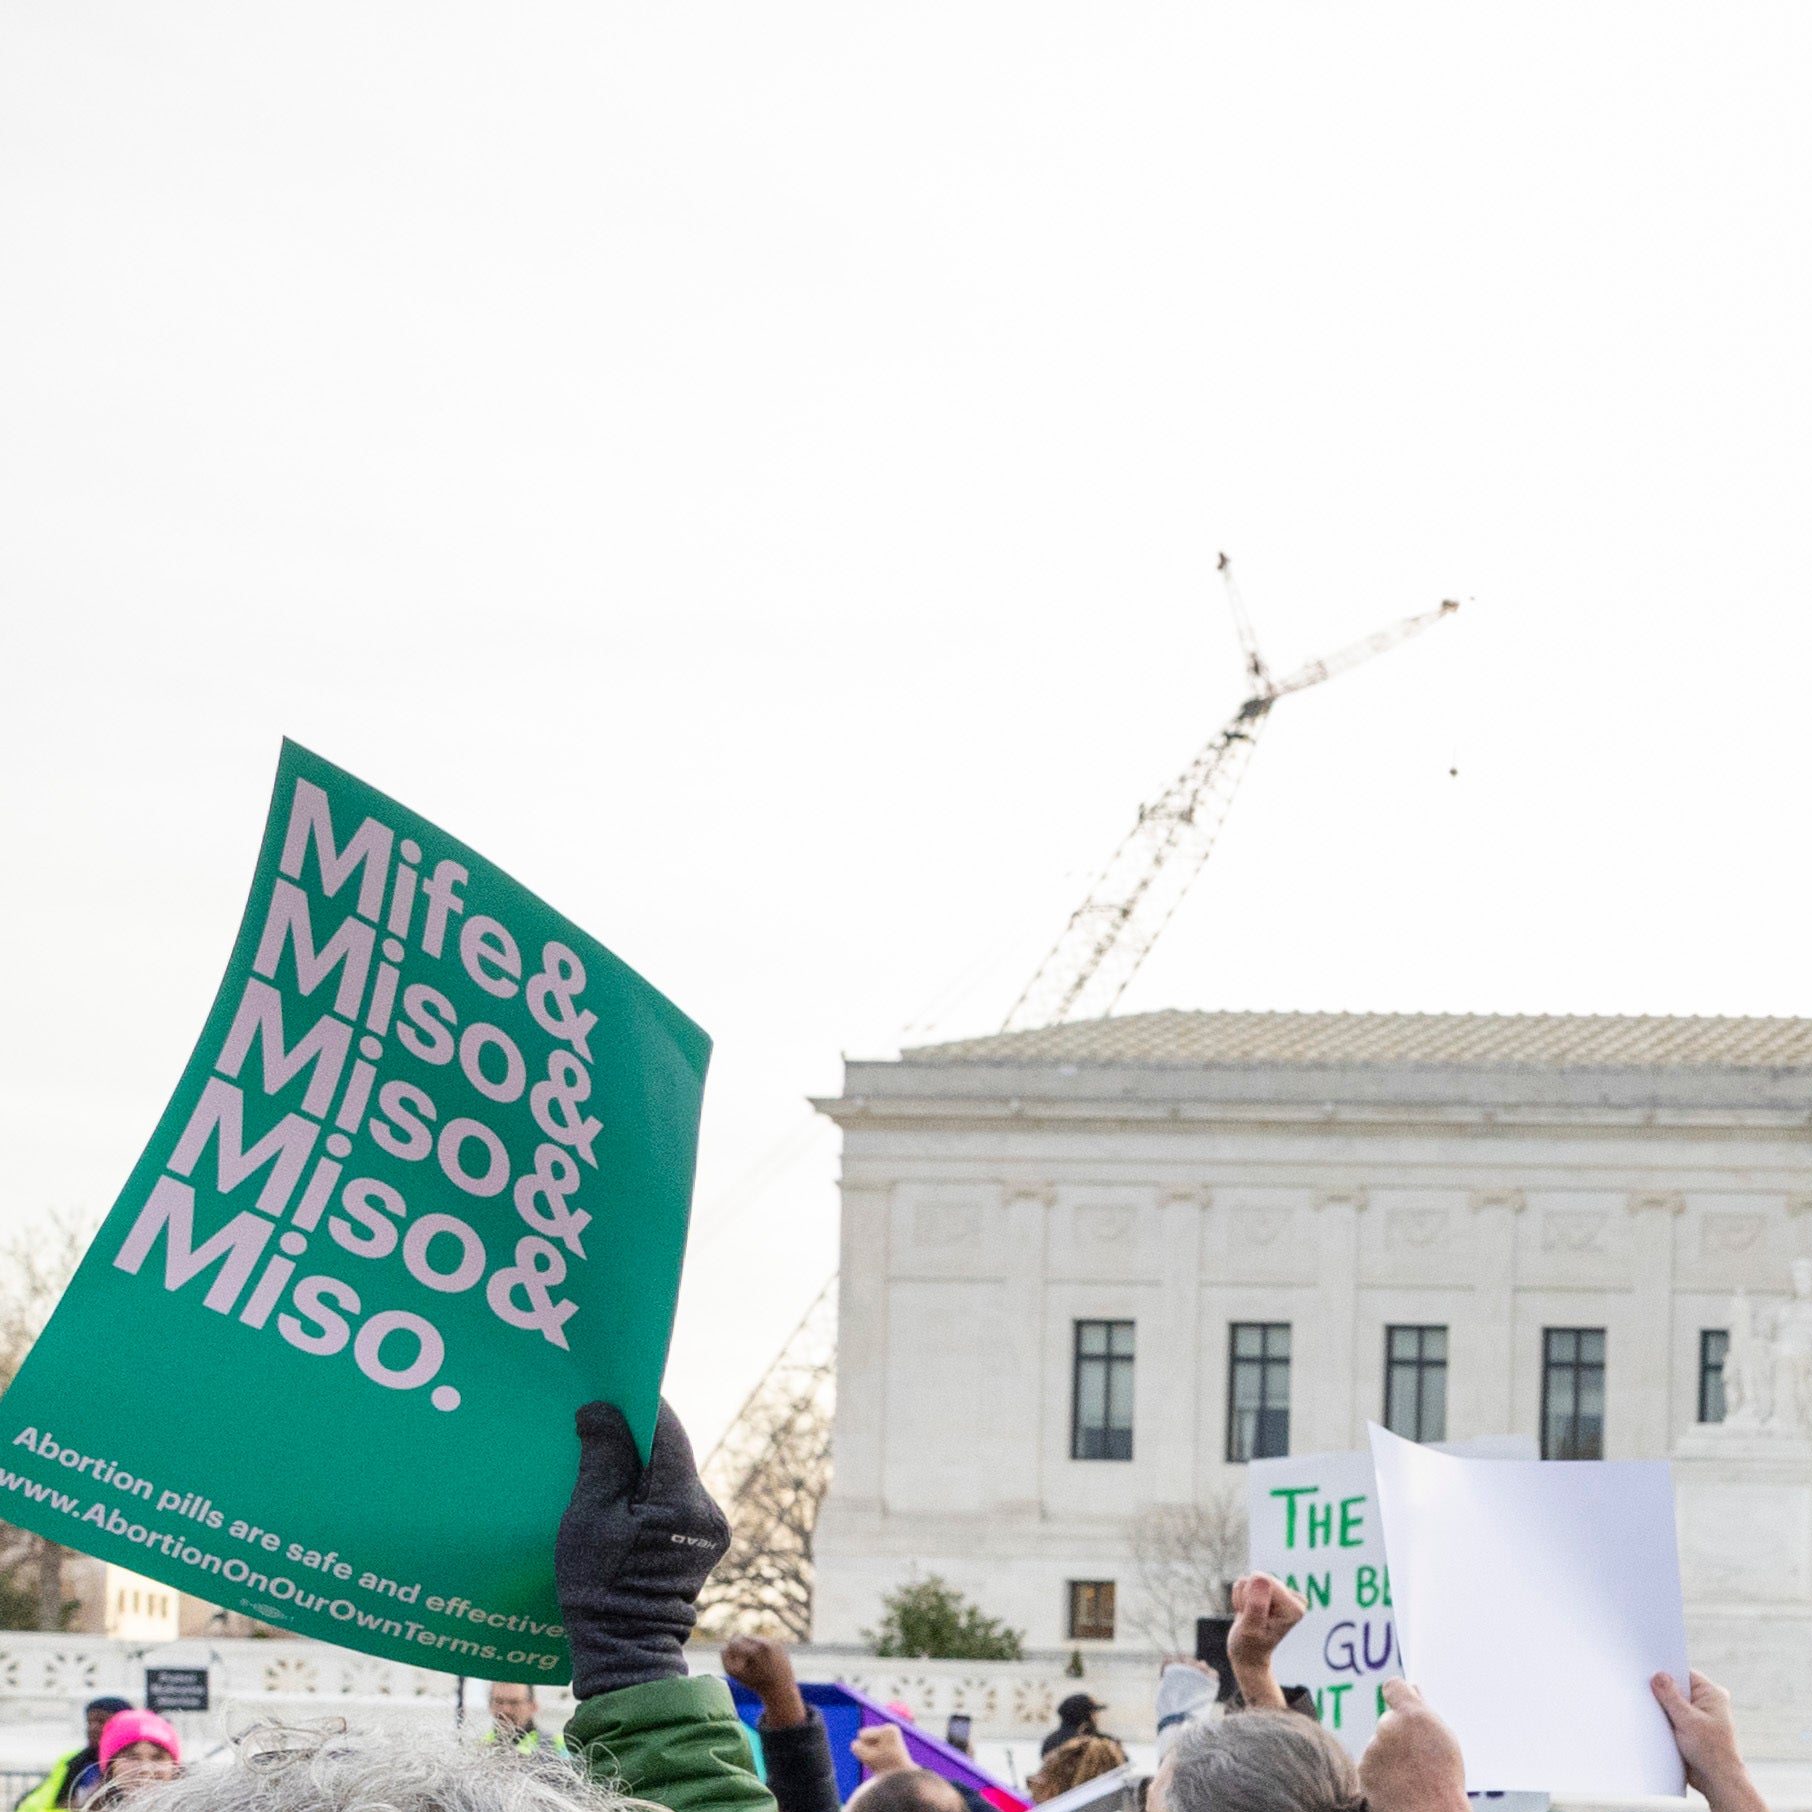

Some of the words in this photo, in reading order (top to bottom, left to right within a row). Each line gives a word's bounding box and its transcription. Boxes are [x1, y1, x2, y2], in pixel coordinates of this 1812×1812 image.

[112, 1174, 462, 1413] Miso.
[0, 1467, 560, 1671] www.AbortionOnOurOwnTerms.org
[12, 1426, 154, 1500] Abortion
[156, 1489, 223, 1529] pills
[229, 1519, 282, 1552] are
[286, 1542, 353, 1580] safe
[358, 1571, 422, 1604] and
[670, 1533, 718, 1550] HEAD
[1269, 1485, 1368, 1549] THE
